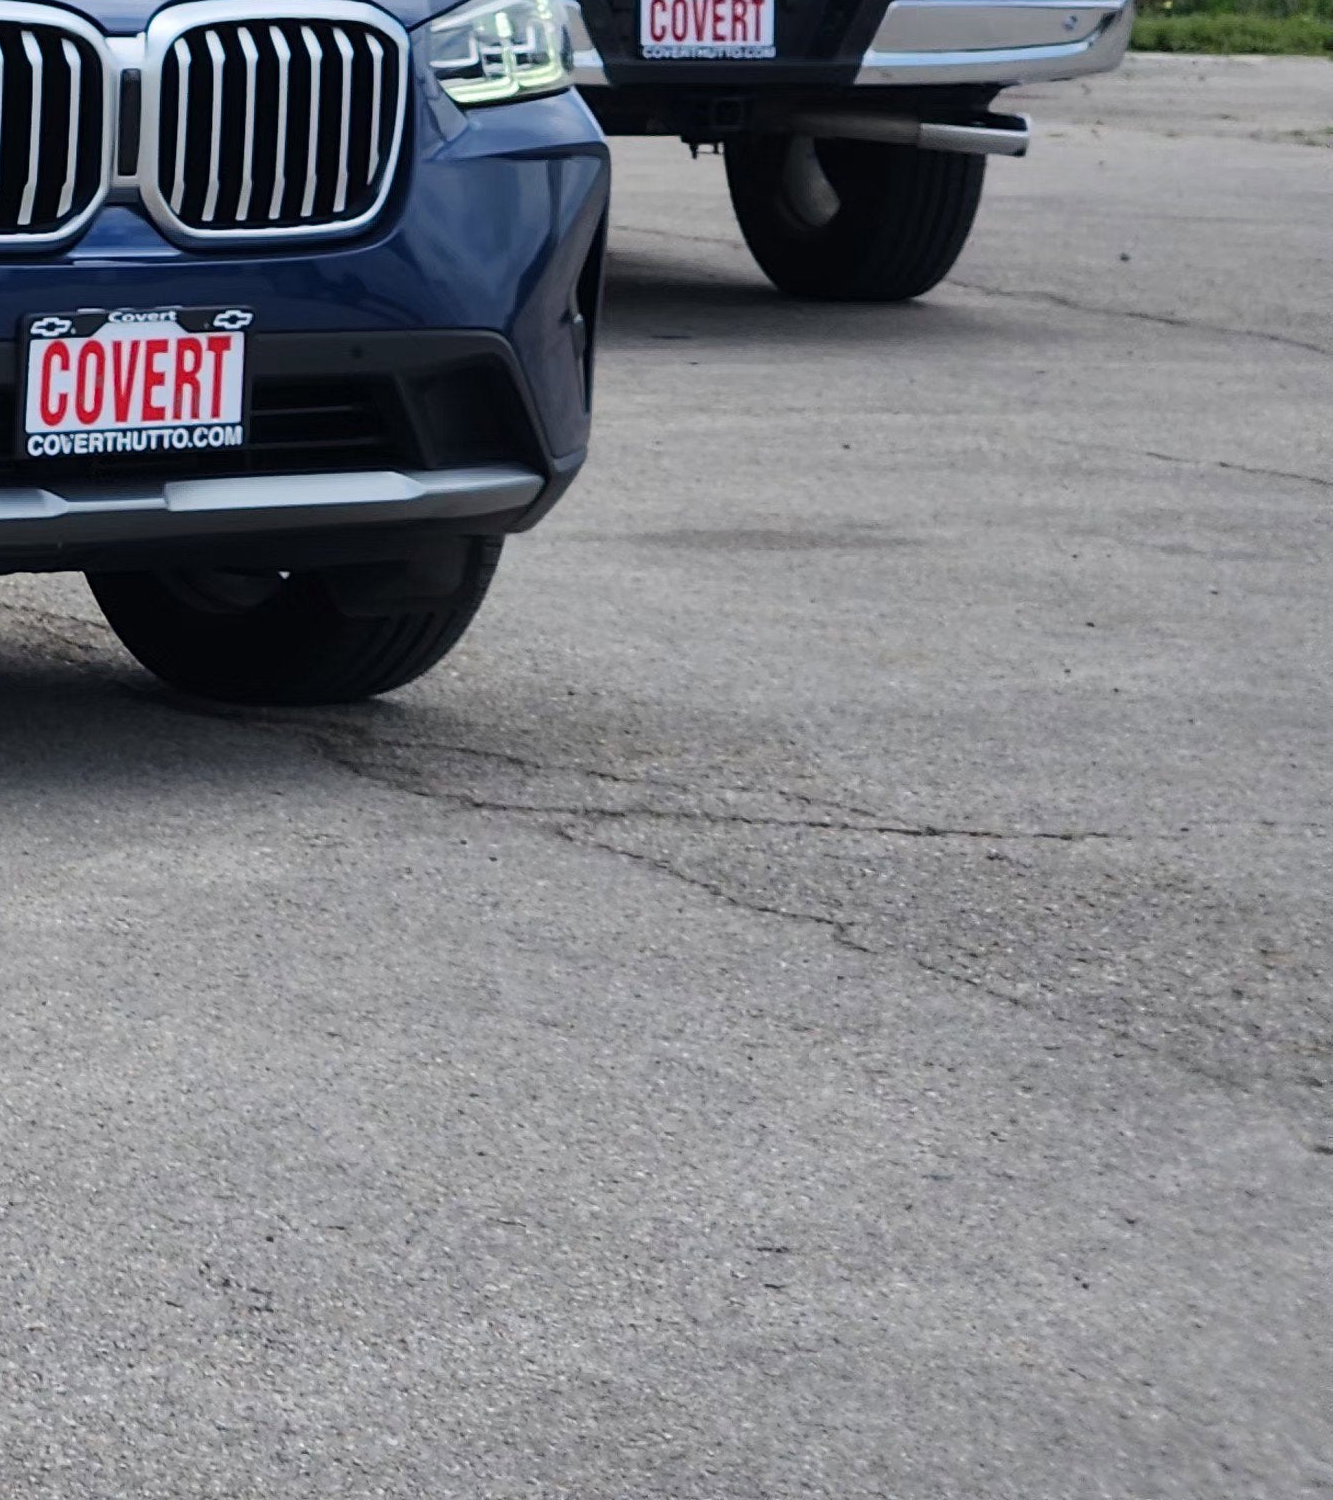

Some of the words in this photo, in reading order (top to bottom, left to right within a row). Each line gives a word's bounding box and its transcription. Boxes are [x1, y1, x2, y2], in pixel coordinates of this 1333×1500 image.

[107, 310, 178, 323] Covert
[40, 336, 232, 427] COVERT
[27, 425, 244, 457] COVERTHUTTO.COM
